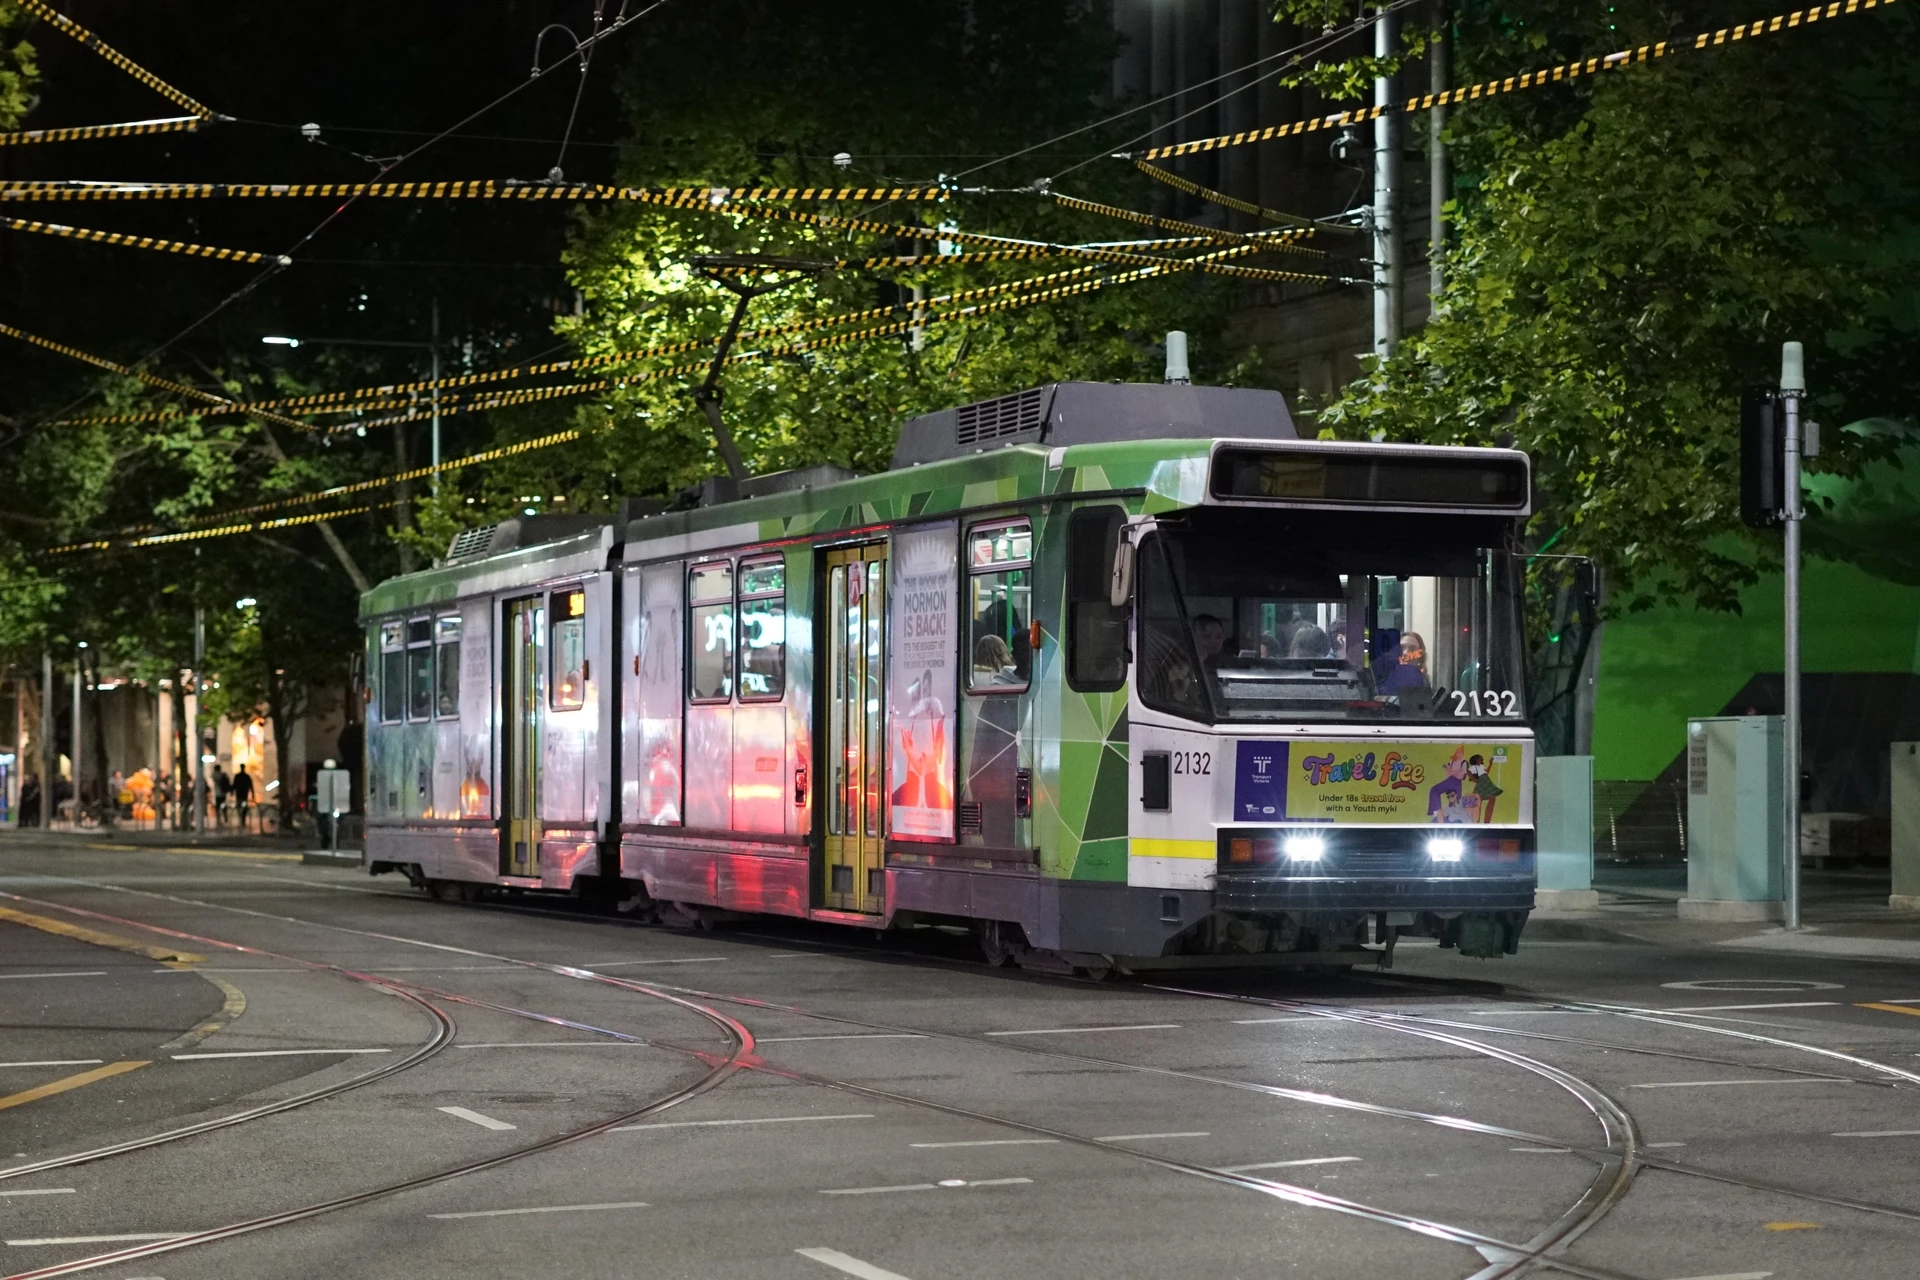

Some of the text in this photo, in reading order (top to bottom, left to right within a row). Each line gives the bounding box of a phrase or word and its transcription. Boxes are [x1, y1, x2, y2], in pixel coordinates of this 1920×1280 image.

[904, 590, 947, 614] MORMON
[904, 613, 946, 638] IS BACK!
[1451, 690, 1520, 716] 2132
[1174, 751, 1211, 775] 2132
[1302, 751, 1424, 787] Travel free
[1318, 794, 1406, 803] Under 18s travel free
[1326, 804, 1344, 812] with
[1378, 805, 1397, 814] myki
